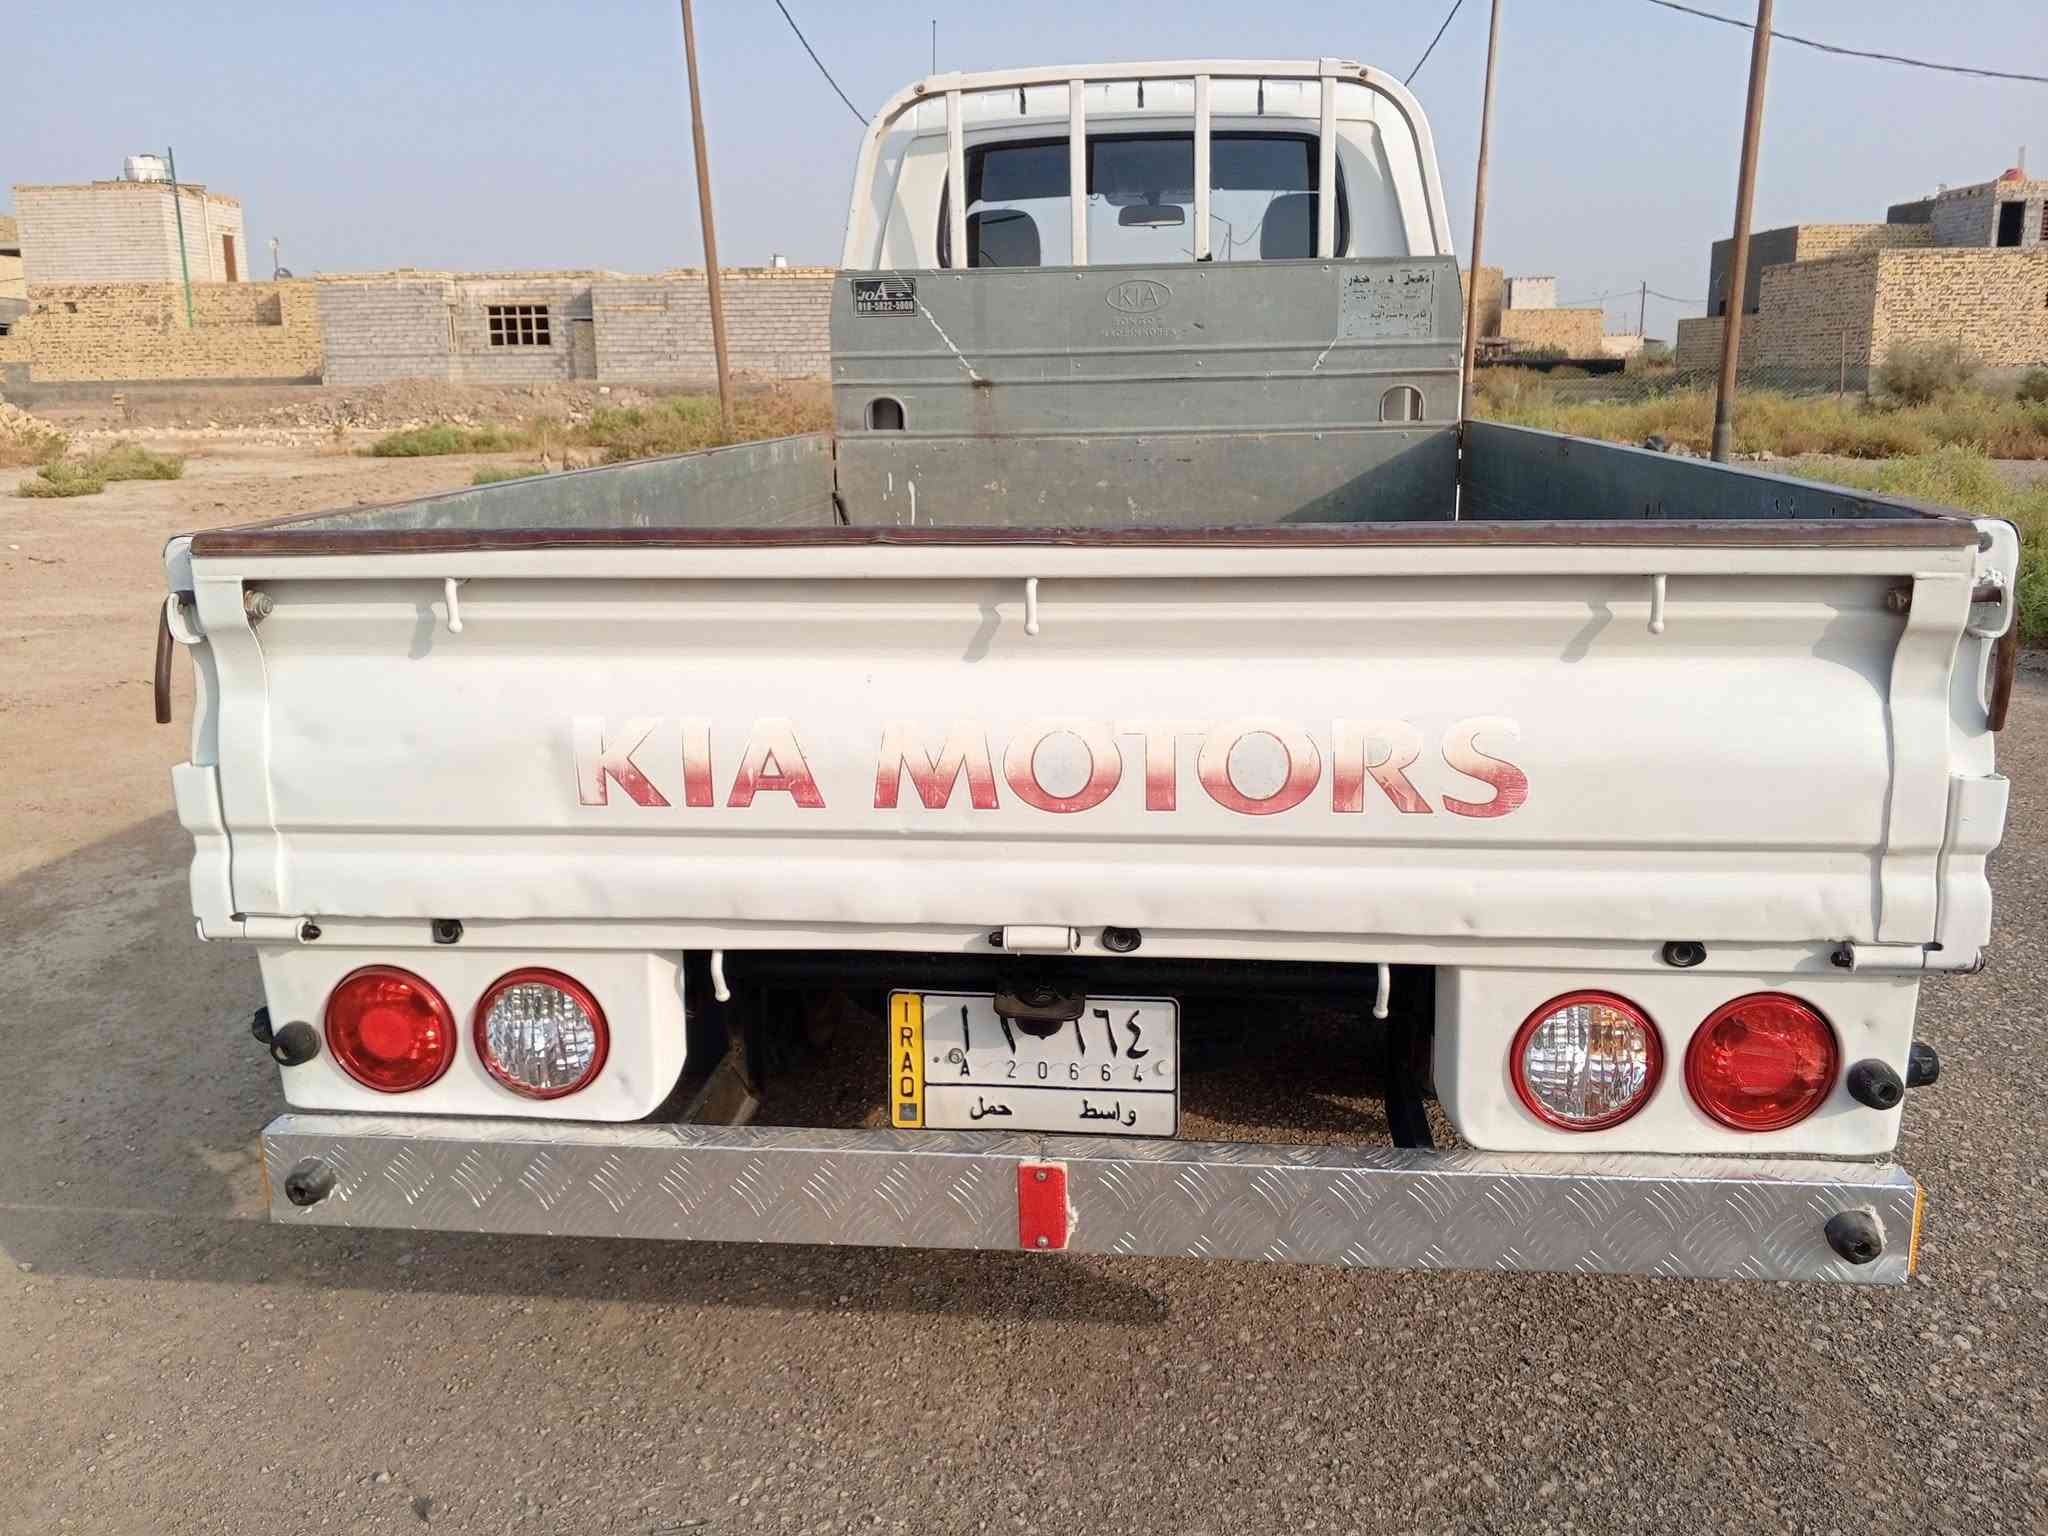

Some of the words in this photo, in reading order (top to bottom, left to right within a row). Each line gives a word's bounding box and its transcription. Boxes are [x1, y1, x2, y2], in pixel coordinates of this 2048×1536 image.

[1118, 286, 1160, 306] KIA
[573, 716, 826, 808] KIA
[873, 716, 1530, 819] MOTORS
[900, 1002, 914, 1098] IRAQ
[970, 1096, 1012, 1120] حمل
[1079, 1099, 1137, 1126] واسط
